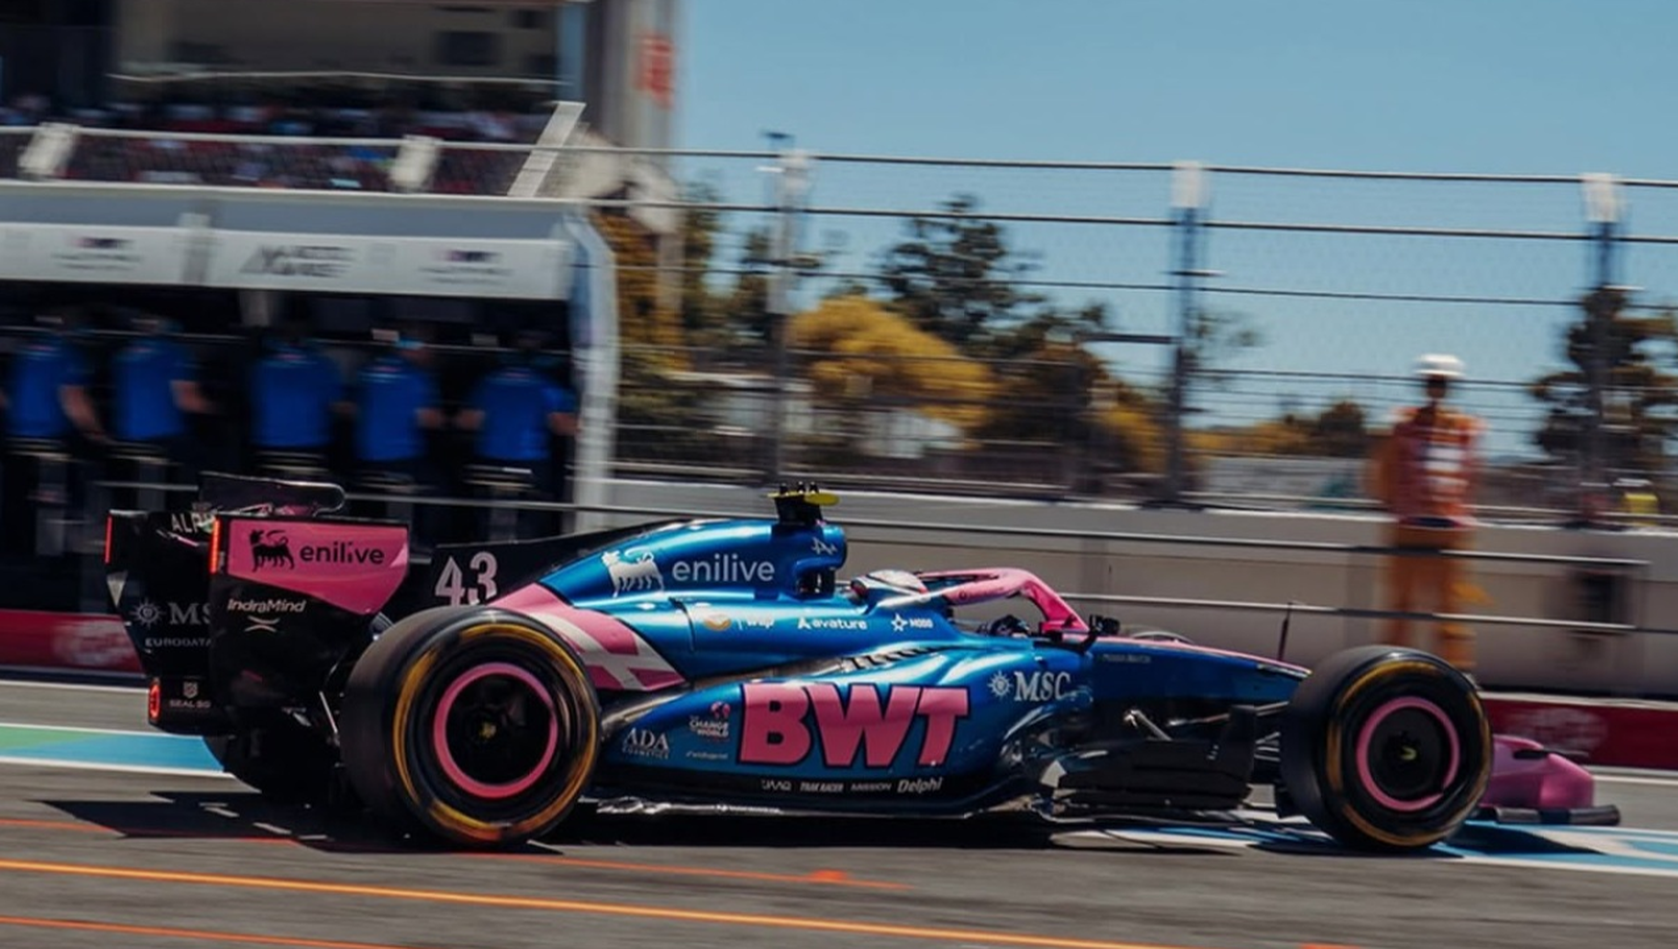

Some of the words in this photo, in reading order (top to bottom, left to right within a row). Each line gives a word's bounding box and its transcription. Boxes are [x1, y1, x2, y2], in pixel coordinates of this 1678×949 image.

[300, 541, 385, 564] enilive
[672, 553, 775, 581] enilive
[435, 552, 498, 606] 43
[227, 599, 306, 613] IndraMind
[812, 616, 867, 630] avature
[1014, 671, 1070, 701] MSC
[738, 682, 969, 767] BWT
[622, 727, 669, 750] ADA
[898, 777, 943, 794] Delphi
